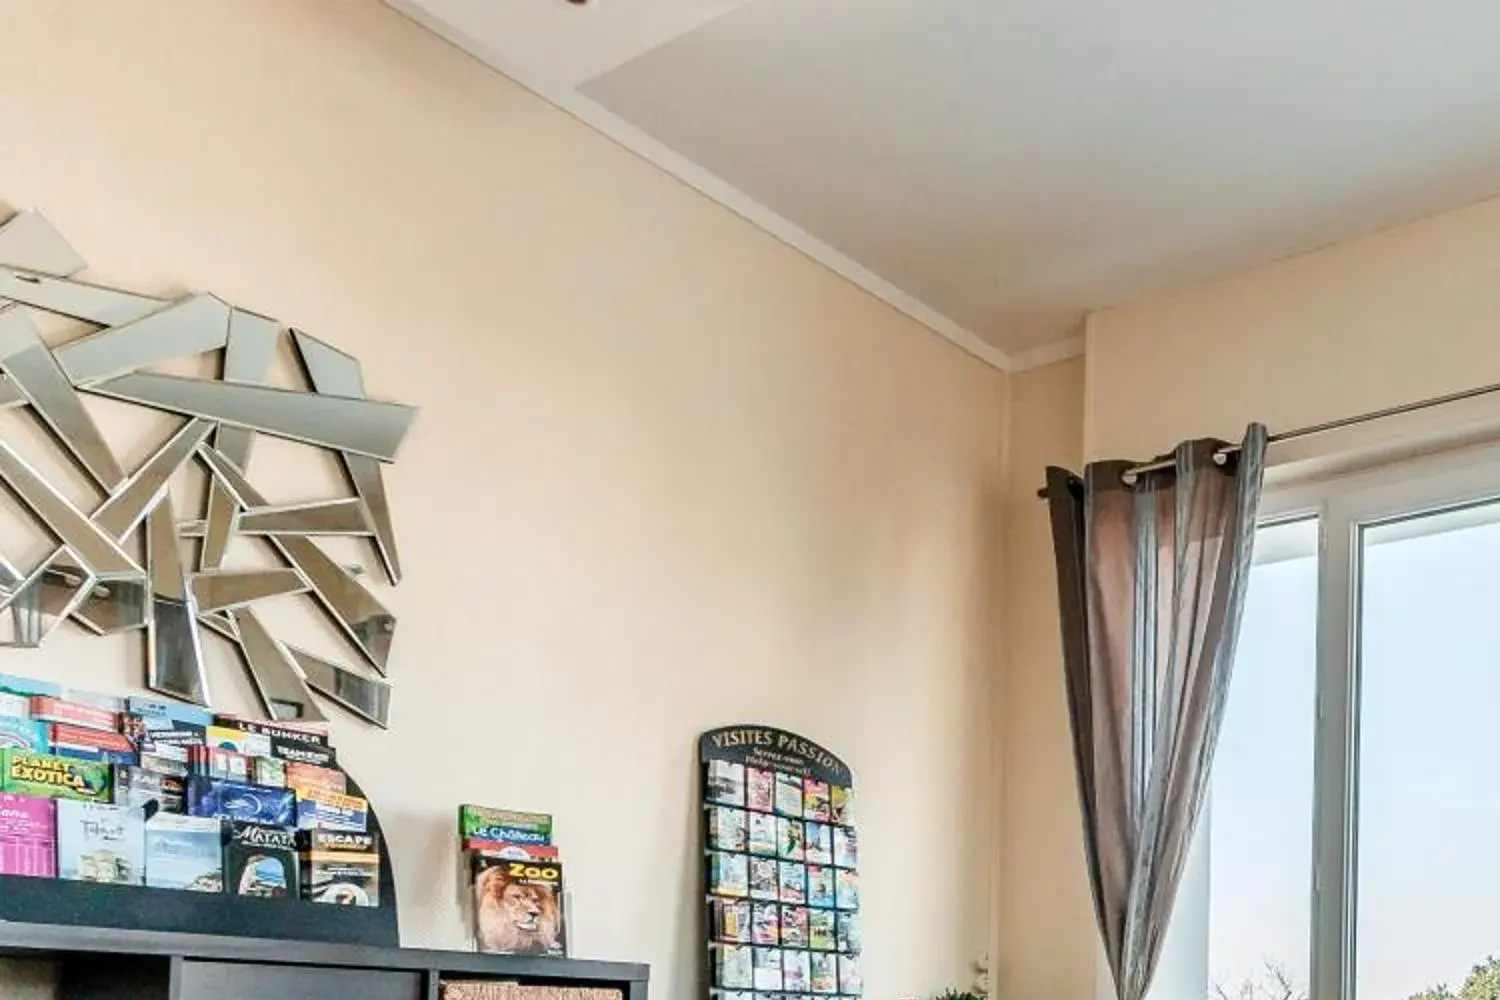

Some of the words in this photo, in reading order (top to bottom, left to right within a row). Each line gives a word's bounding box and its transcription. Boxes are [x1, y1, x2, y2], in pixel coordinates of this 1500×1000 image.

[262, 728, 321, 744] BUNKER
[712, 730, 773, 748] VISITES
[12, 755, 70, 772] PLANET
[11, 766, 85, 788] EXOTICA
[317, 833, 373, 846] ESCAPE
